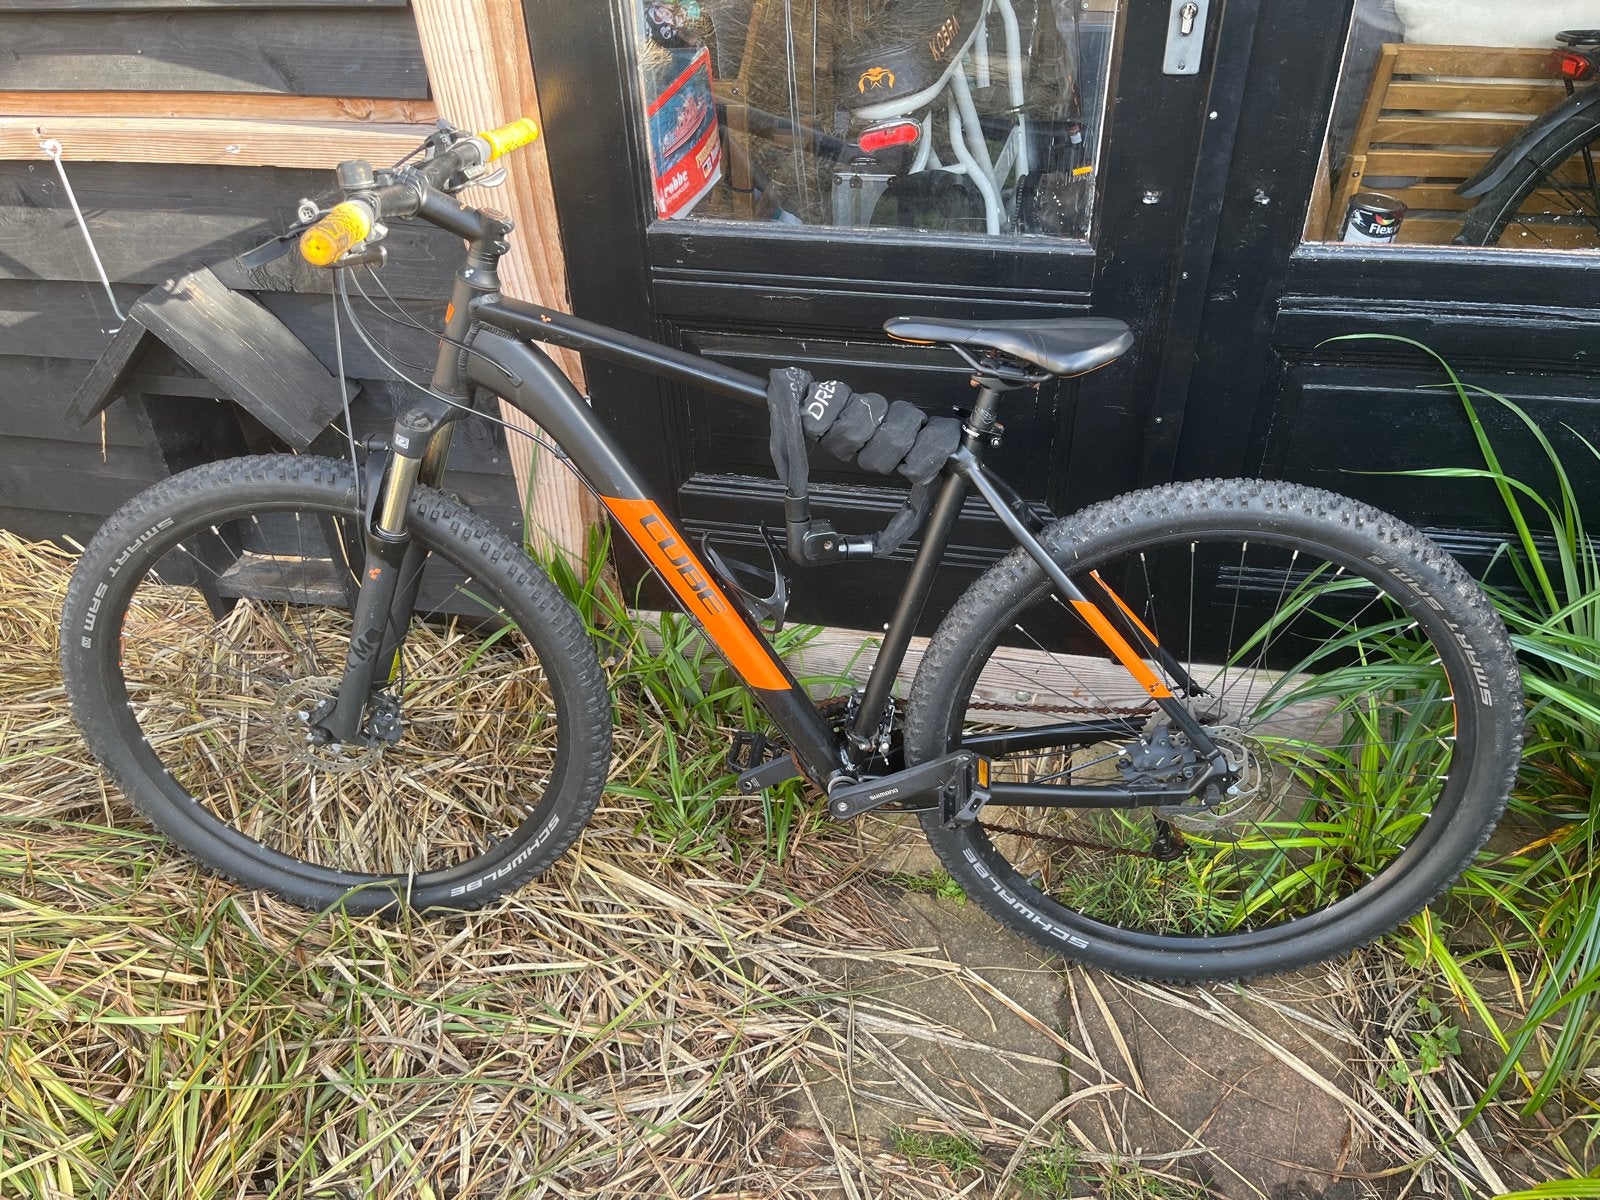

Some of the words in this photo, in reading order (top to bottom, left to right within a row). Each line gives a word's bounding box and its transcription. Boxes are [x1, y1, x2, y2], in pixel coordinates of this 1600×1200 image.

[663, 170, 688, 198] robbe
[108, 517, 175, 578] SMART
[639, 513, 727, 616] CUBE
[83, 582, 109, 632] SAM
[1388, 567, 1445, 611] SAM
[1442, 618, 1493, 707] SMART
[869, 787, 899, 801] SHIMANO
[450, 813, 560, 897] SCHWALBE
[962, 847, 1090, 949] SCHWALBE
